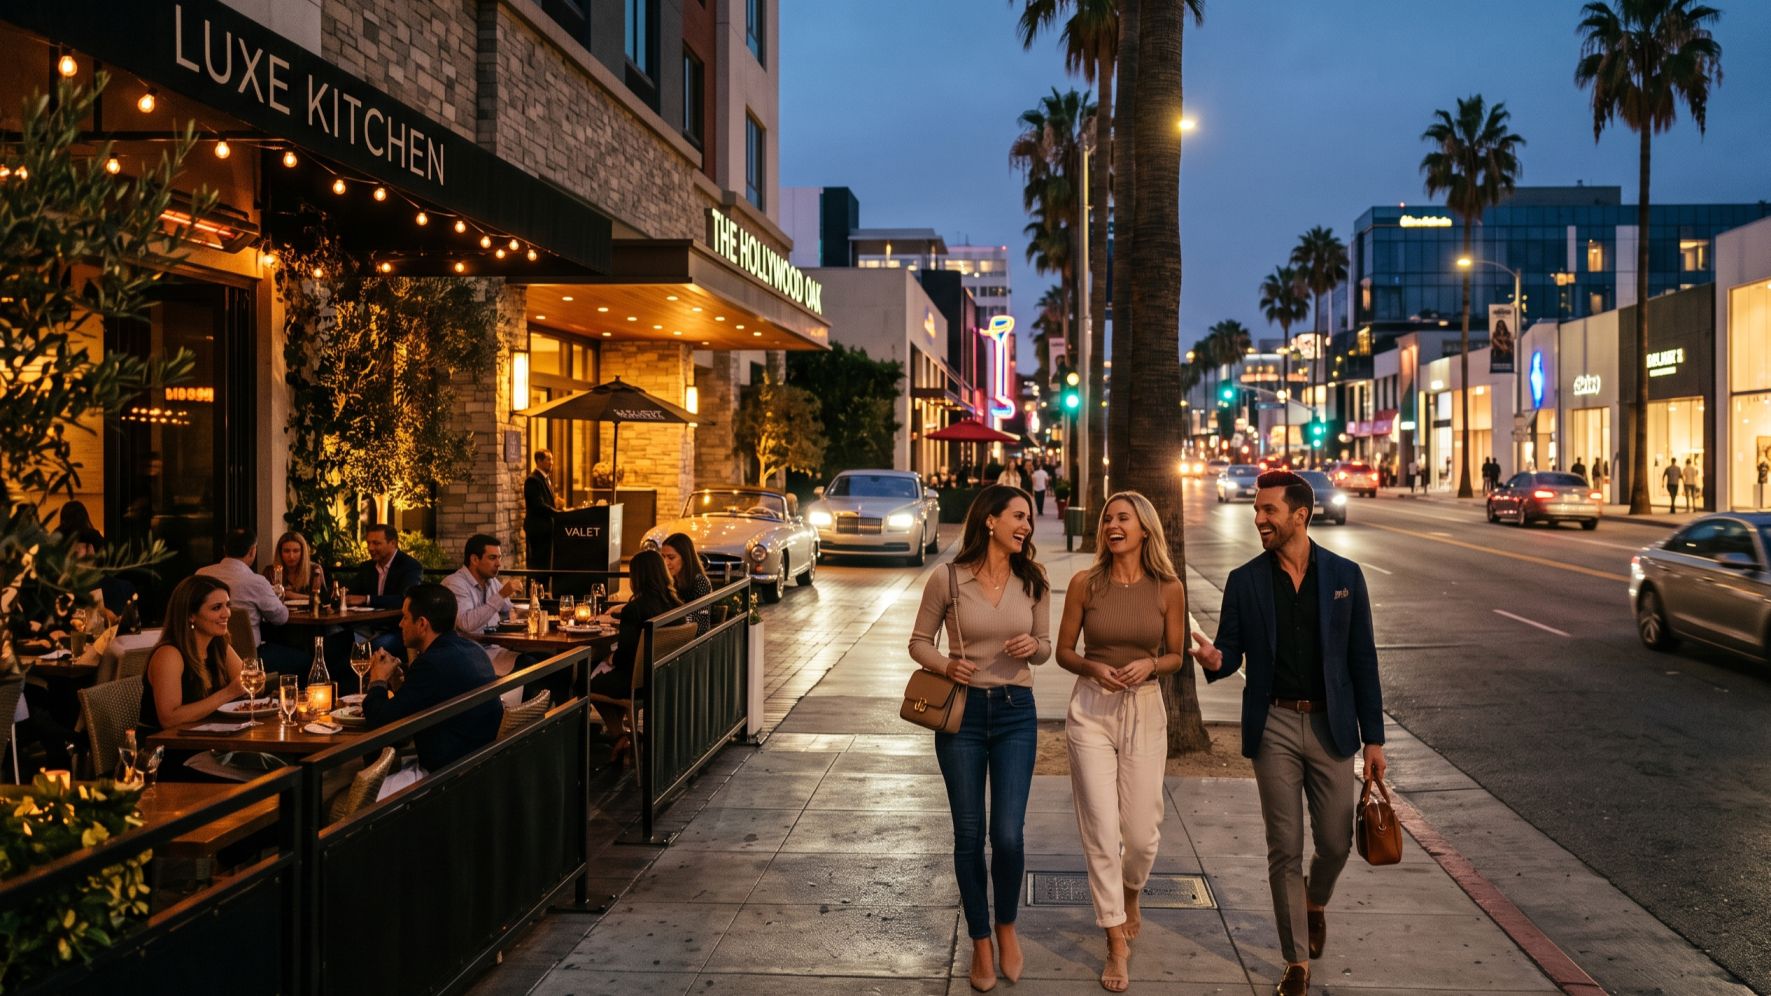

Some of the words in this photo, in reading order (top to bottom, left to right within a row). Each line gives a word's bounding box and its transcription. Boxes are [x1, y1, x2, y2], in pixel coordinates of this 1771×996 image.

[176, 4, 290, 115] LUXE
[308, 74, 444, 185] KITCHEN
[712, 208, 738, 264] THE
[740, 228, 804, 303] HOLLYWOOD
[805, 276, 822, 315] OAK
[565, 527, 600, 537] VALET
